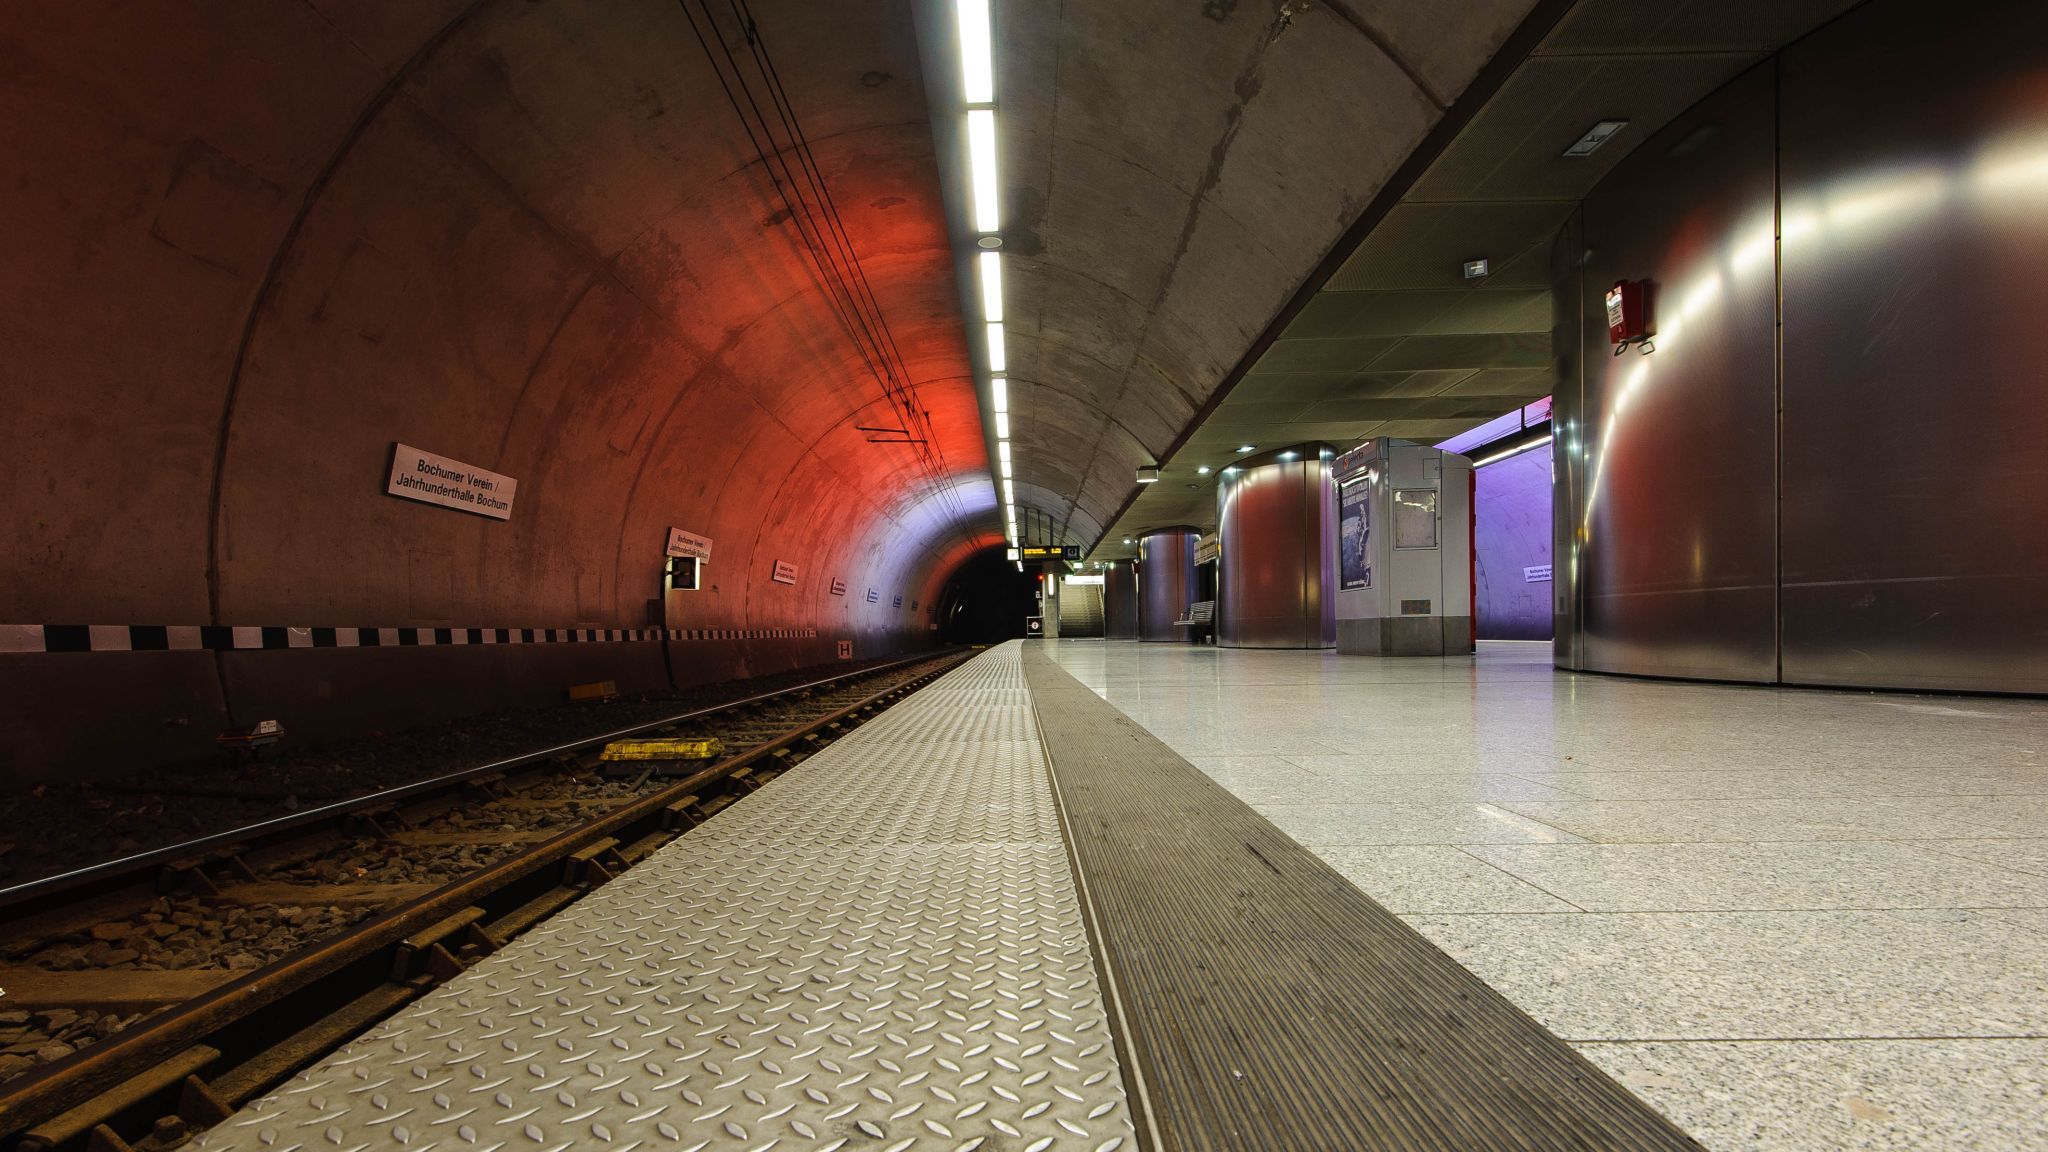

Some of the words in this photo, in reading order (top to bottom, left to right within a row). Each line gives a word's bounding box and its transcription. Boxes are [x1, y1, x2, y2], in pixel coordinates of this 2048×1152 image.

[417, 459, 464, 483] Bochumer
[467, 473, 493, 490] Verein
[396, 473, 475, 503] Jahrhunderthalle
[476, 493, 508, 511] Bochum
[840, 643, 850, 656] H
